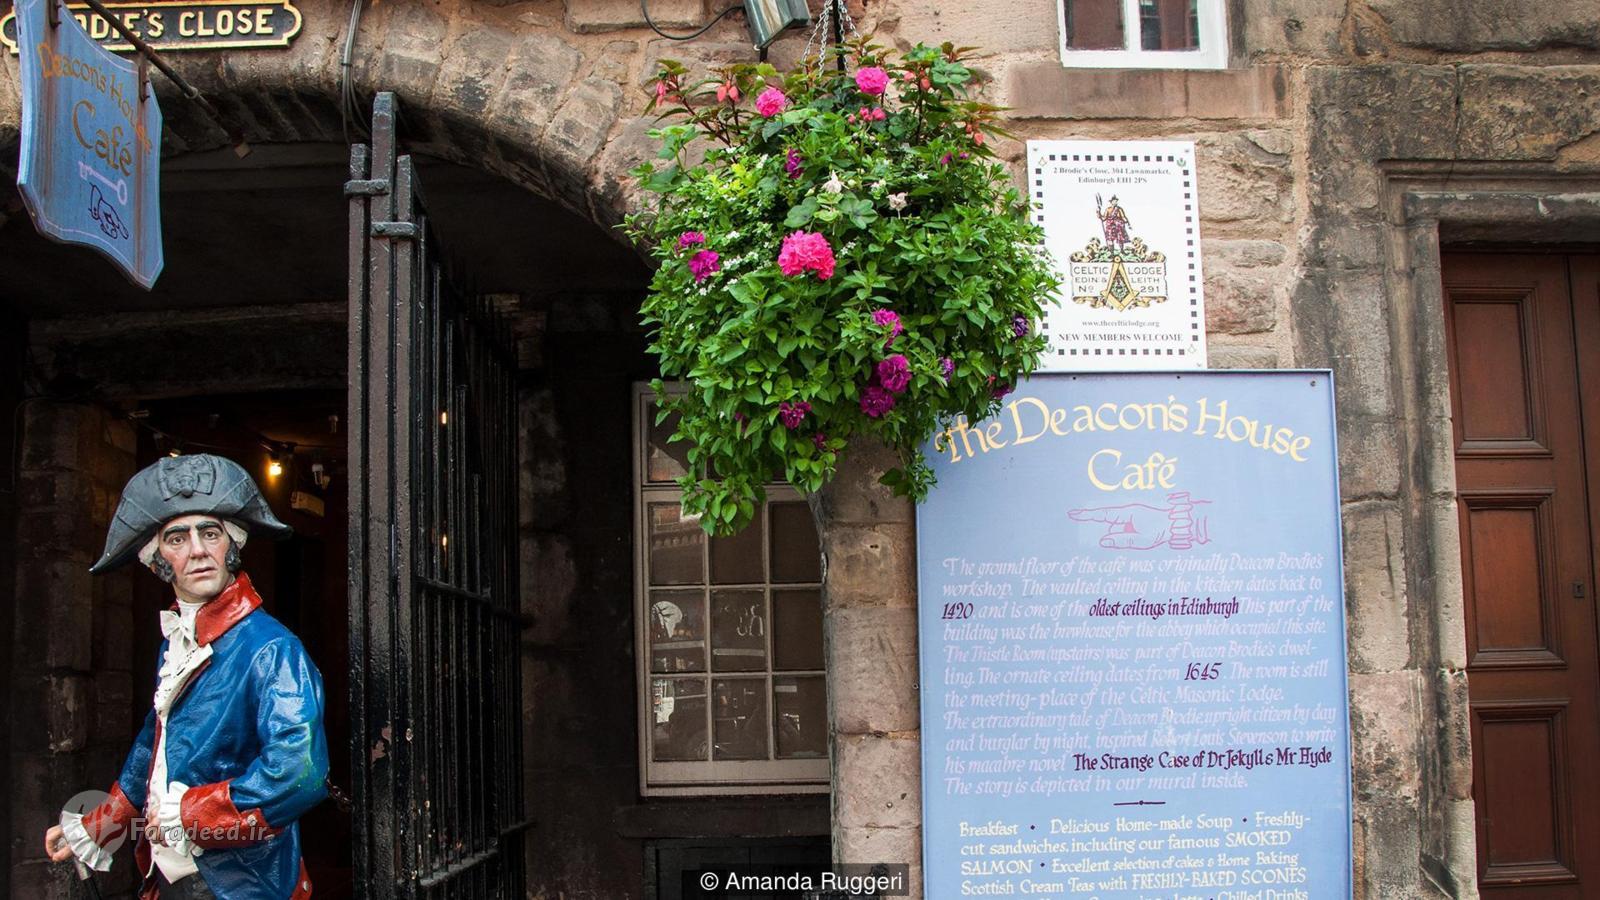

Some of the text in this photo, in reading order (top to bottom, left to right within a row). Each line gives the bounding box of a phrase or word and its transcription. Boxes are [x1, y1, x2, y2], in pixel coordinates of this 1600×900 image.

[74, 8, 274, 39] DIE'S CLOSE
[72, 99, 133, 177] Café
[1073, 266, 1163, 275] CELTIC LODGE
[1058, 333, 1182, 341] NEW MEMBERS WELCOME
[1007, 395, 1189, 446] Deacon's
[1194, 398, 1311, 462] House
[1087, 449, 1179, 492] Café
[942, 557, 975, 576] The
[978, 557, 1022, 578] ground
[1022, 556, 1057, 577] floor
[1079, 556, 1096, 573] the
[1099, 556, 1126, 576] café
[1158, 552, 1227, 574] originally
[1229, 552, 1275, 571] Deacon
[1021, 578, 1049, 597] The
[1050, 577, 1100, 596] vaulted
[1103, 576, 1148, 595] ceiling
[1170, 575, 1190, 592] the
[1195, 574, 1244, 592] kitchen
[1246, 574, 1276, 591] dates
[1279, 574, 1306, 591] back
[978, 601, 1007, 618] and
[1024, 604, 1046, 618] one
[1068, 601, 1088, 617] the
[1089, 597, 1120, 617] oldest
[1121, 597, 1166, 620] ceilings
[1180, 595, 1239, 619] Edinburgh
[1239, 596, 1265, 614] This
[1268, 598, 1295, 616] part
[1313, 595, 1334, 613] the
[943, 623, 998, 644] building
[1029, 623, 1049, 640] the
[1136, 621, 1156, 637] the
[1158, 619, 1193, 639] abbey
[1193, 619, 1229, 636] which
[1230, 619, 1281, 640] occupied
[1282, 618, 1303, 634] this
[944, 644, 969, 663] The
[970, 645, 1011, 661] Thistle
[1012, 644, 1046, 661] Room
[1135, 644, 1164, 662] part
[1182, 641, 1229, 659] Deacon
[978, 667, 1000, 684] The
[1003, 667, 1051, 684] ornate
[1054, 665, 1101, 687] ceiling
[1105, 662, 1143, 683] dates
[1143, 664, 1179, 685] from
[1231, 662, 1254, 679] The
[1256, 666, 1287, 679] room
[1301, 658, 1329, 678] still
[944, 690, 968, 708] the
[1101, 687, 1126, 705] the
[1130, 686, 1171, 705] Celtic
[1174, 685, 1235, 704] Masonic
[943, 702, 1337, 731] The extraordinary Deacon upright citizen by day
[945, 727, 1337, 755] and burglar by inspired Louis Stevenson write
[944, 756, 965, 774] his
[968, 756, 1026, 773] macabre
[1029, 755, 1067, 772] novel
[1073, 753, 1098, 771] The
[1100, 752, 1154, 772] Strange
[1158, 751, 1190, 768] Case
[1192, 750, 1206, 767] of
[1207, 751, 1224, 768] Dr
[1224, 748, 1264, 770] Jekyll
[1276, 747, 1297, 766] Mr
[944, 777, 972, 795] The
[975, 779, 1013, 798] story
[1030, 776, 1091, 797] depicted
[1115, 777, 1147, 792] our
[1150, 773, 1196, 790] mural
[959, 811, 1311, 837] Breakfast Delicious Home-made Soup Freshly-
[960, 842, 985, 856] cut
[1071, 837, 1136, 854] including
[1138, 838, 1164, 850] our
[1167, 833, 1220, 850] famous
[1225, 830, 1292, 848] SMOKED
[960, 859, 1034, 876] SALMON
[1051, 858, 1109, 873] Excellent
[1113, 855, 1160, 871] selection
[1161, 856, 1173, 868] of
[1174, 854, 1204, 869] cakes
[1217, 853, 1249, 867] Home
[1256, 851, 1299, 867] Baking
[960, 867, 1307, 896] Scottish Cream Teas with FRESHLY-BAKED SCONES
